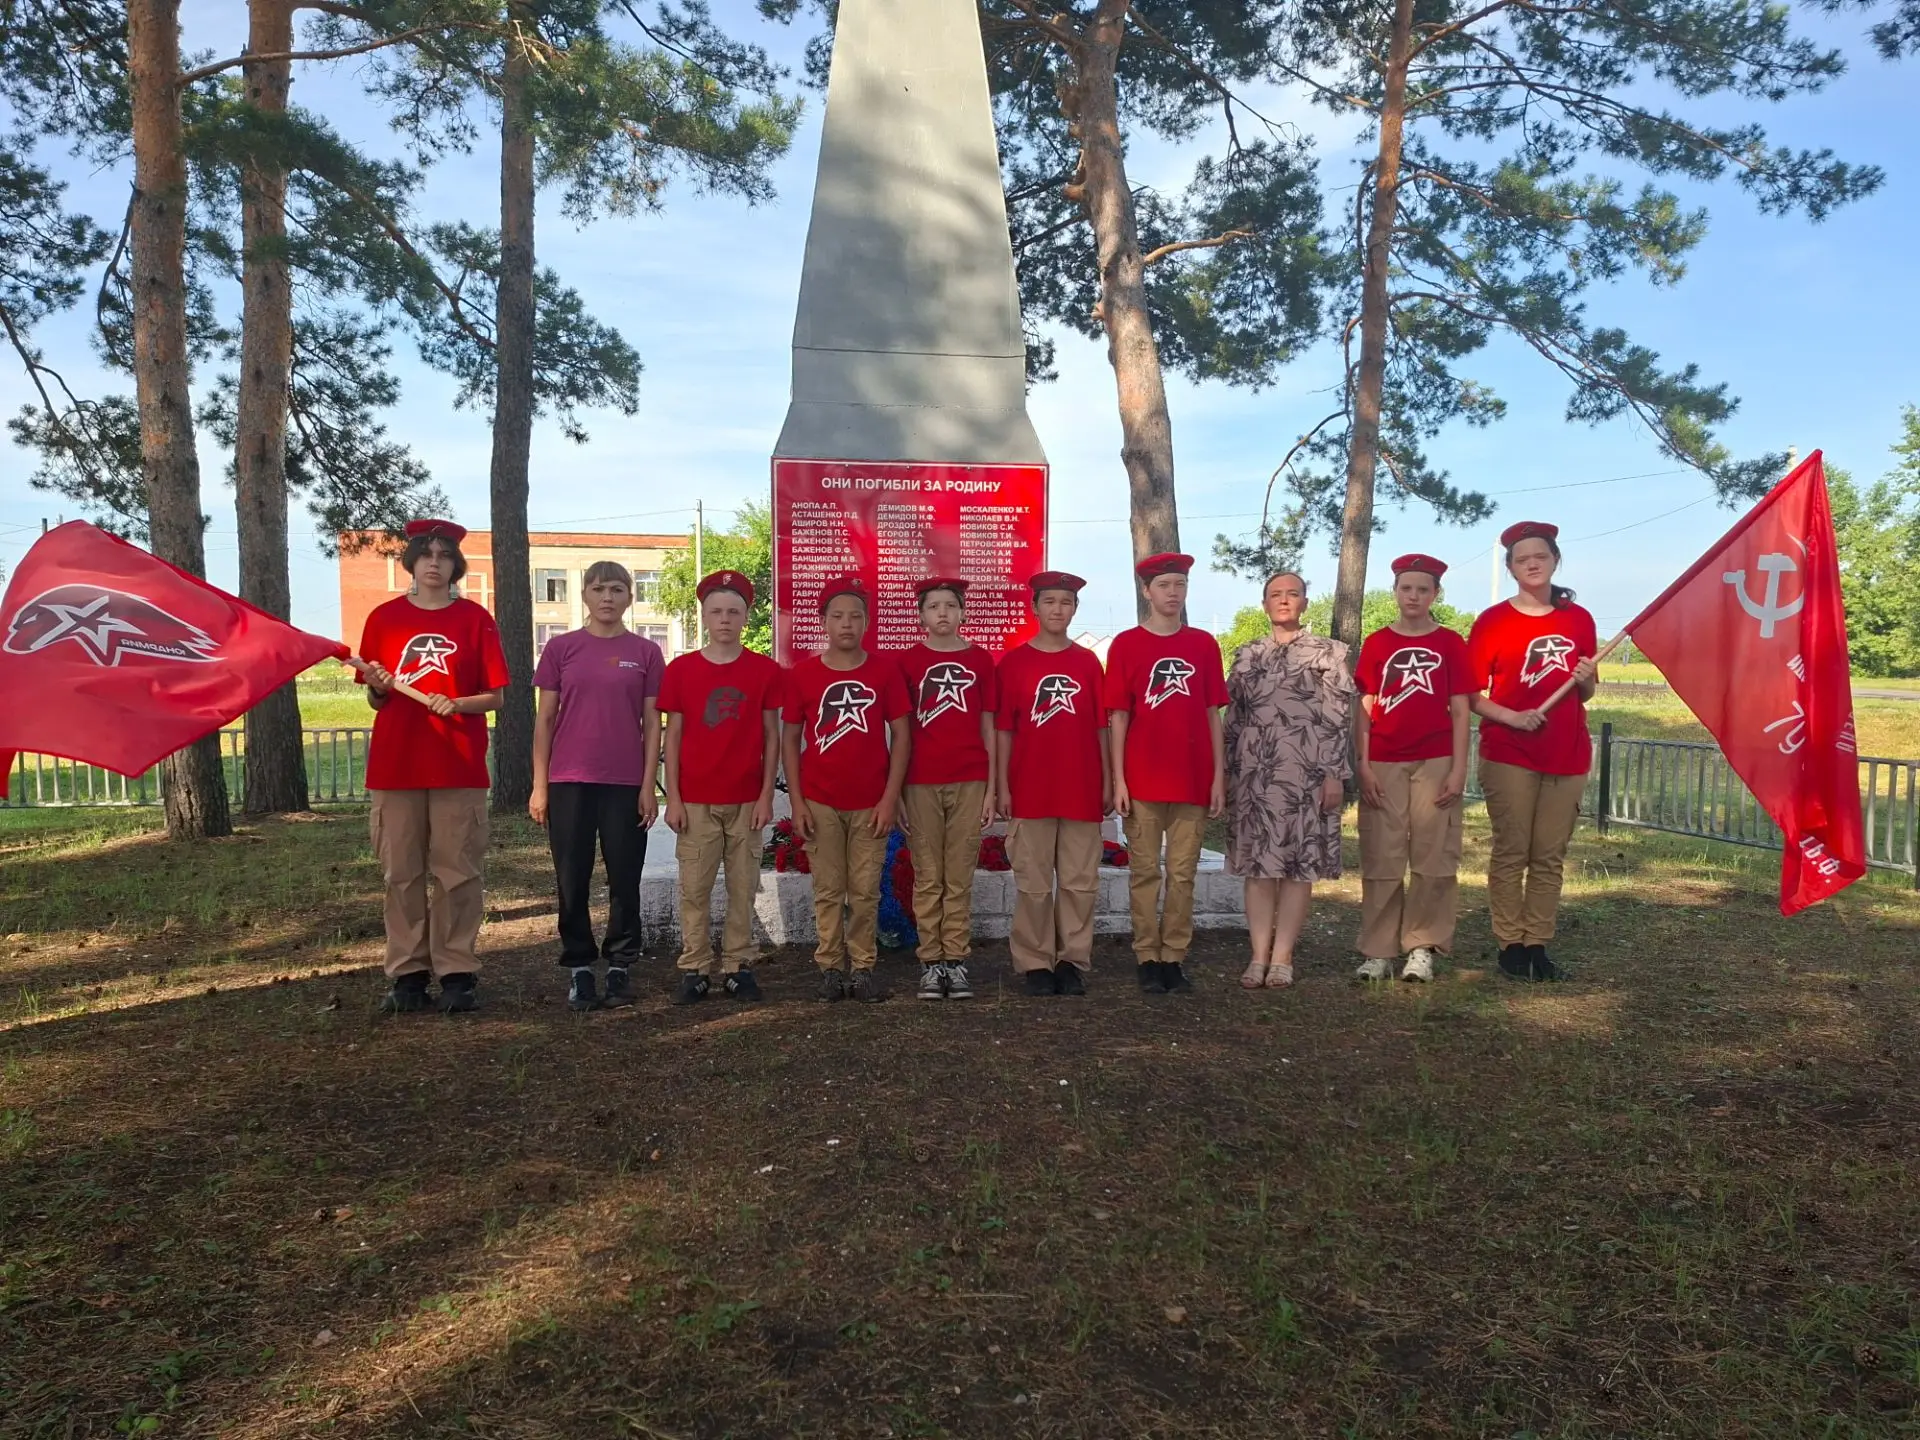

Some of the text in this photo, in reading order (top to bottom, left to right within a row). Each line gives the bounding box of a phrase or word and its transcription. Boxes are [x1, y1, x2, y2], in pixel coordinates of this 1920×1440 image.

[822, 478, 1001, 493] ОНИ ПОГИБЛИ ЗА РОДИНУ
[878, 556, 909, 564] ЗАЙЦЕВ
